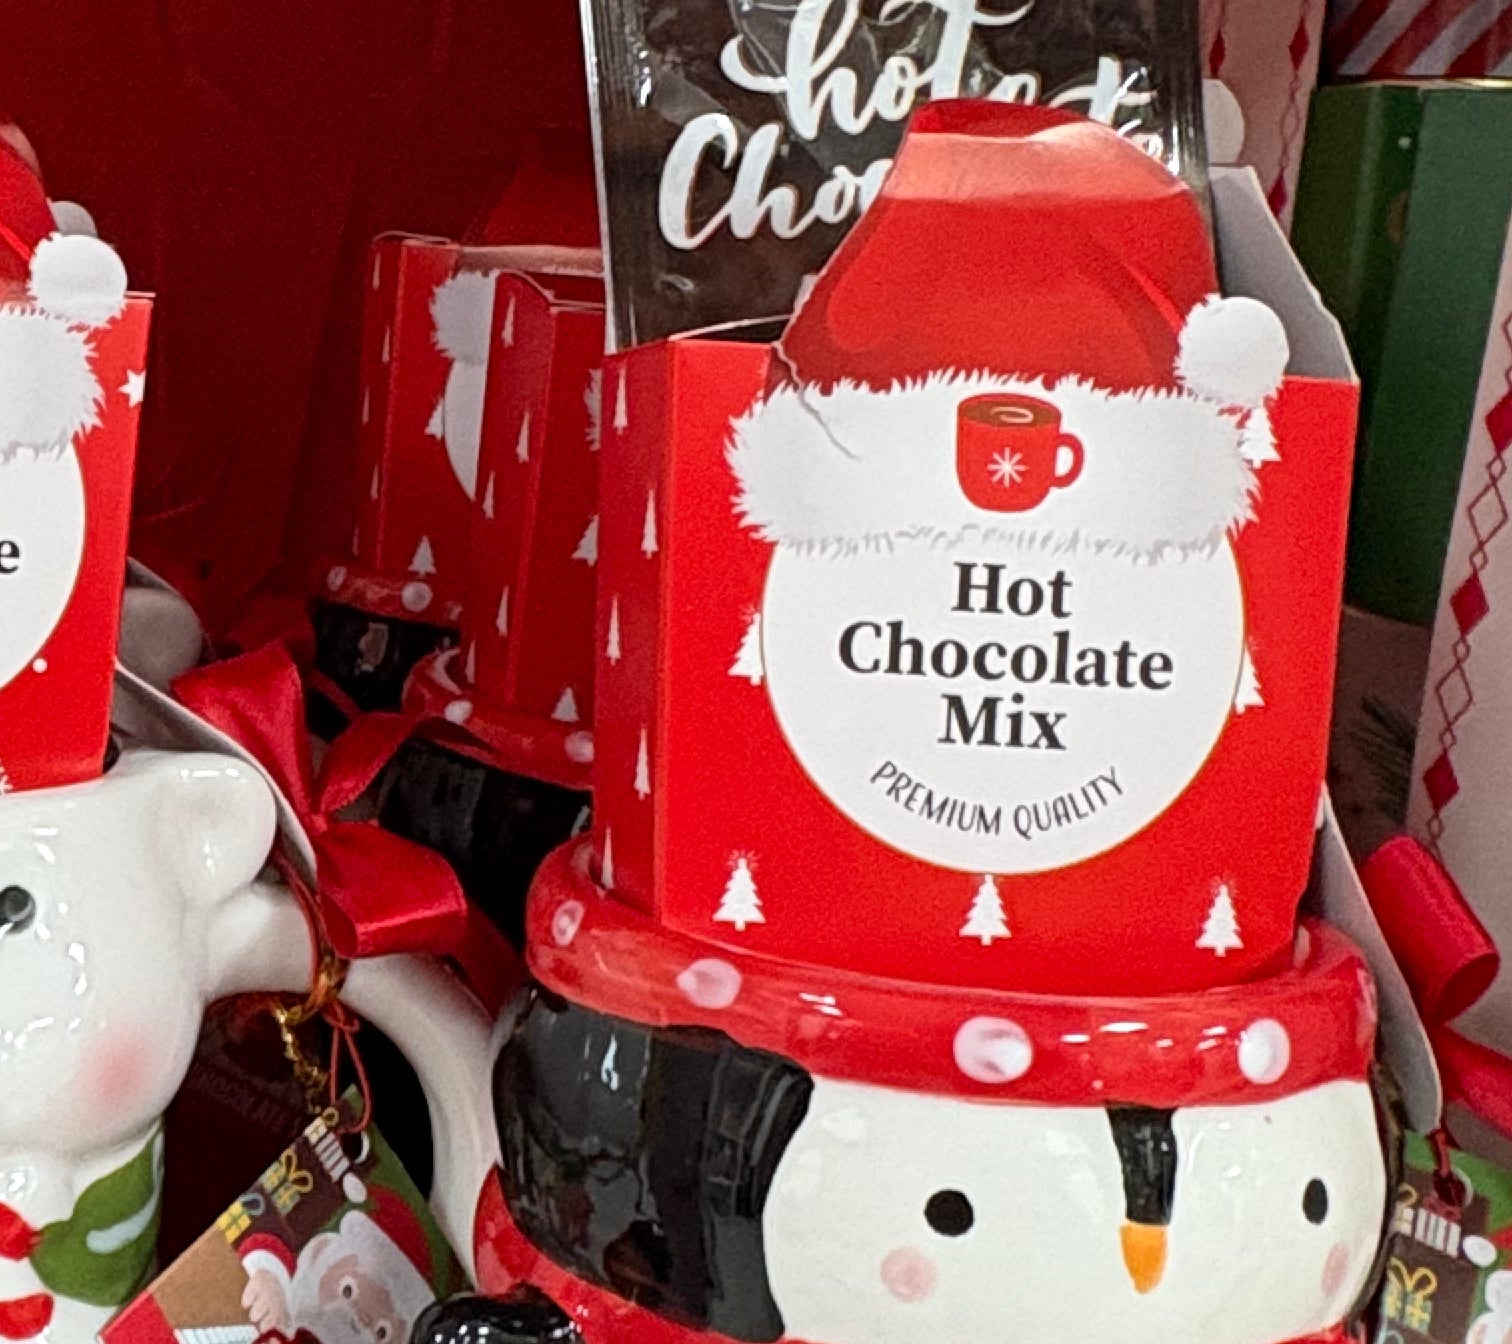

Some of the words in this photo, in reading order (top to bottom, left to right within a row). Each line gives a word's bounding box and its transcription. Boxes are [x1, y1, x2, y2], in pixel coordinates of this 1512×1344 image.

[950, 561, 1073, 619] Hot
[838, 620, 1174, 690] Chocolate
[937, 693, 1067, 751] Mix
[870, 760, 1002, 836] PREMIUM
[1012, 766, 1124, 841] QUALITY
